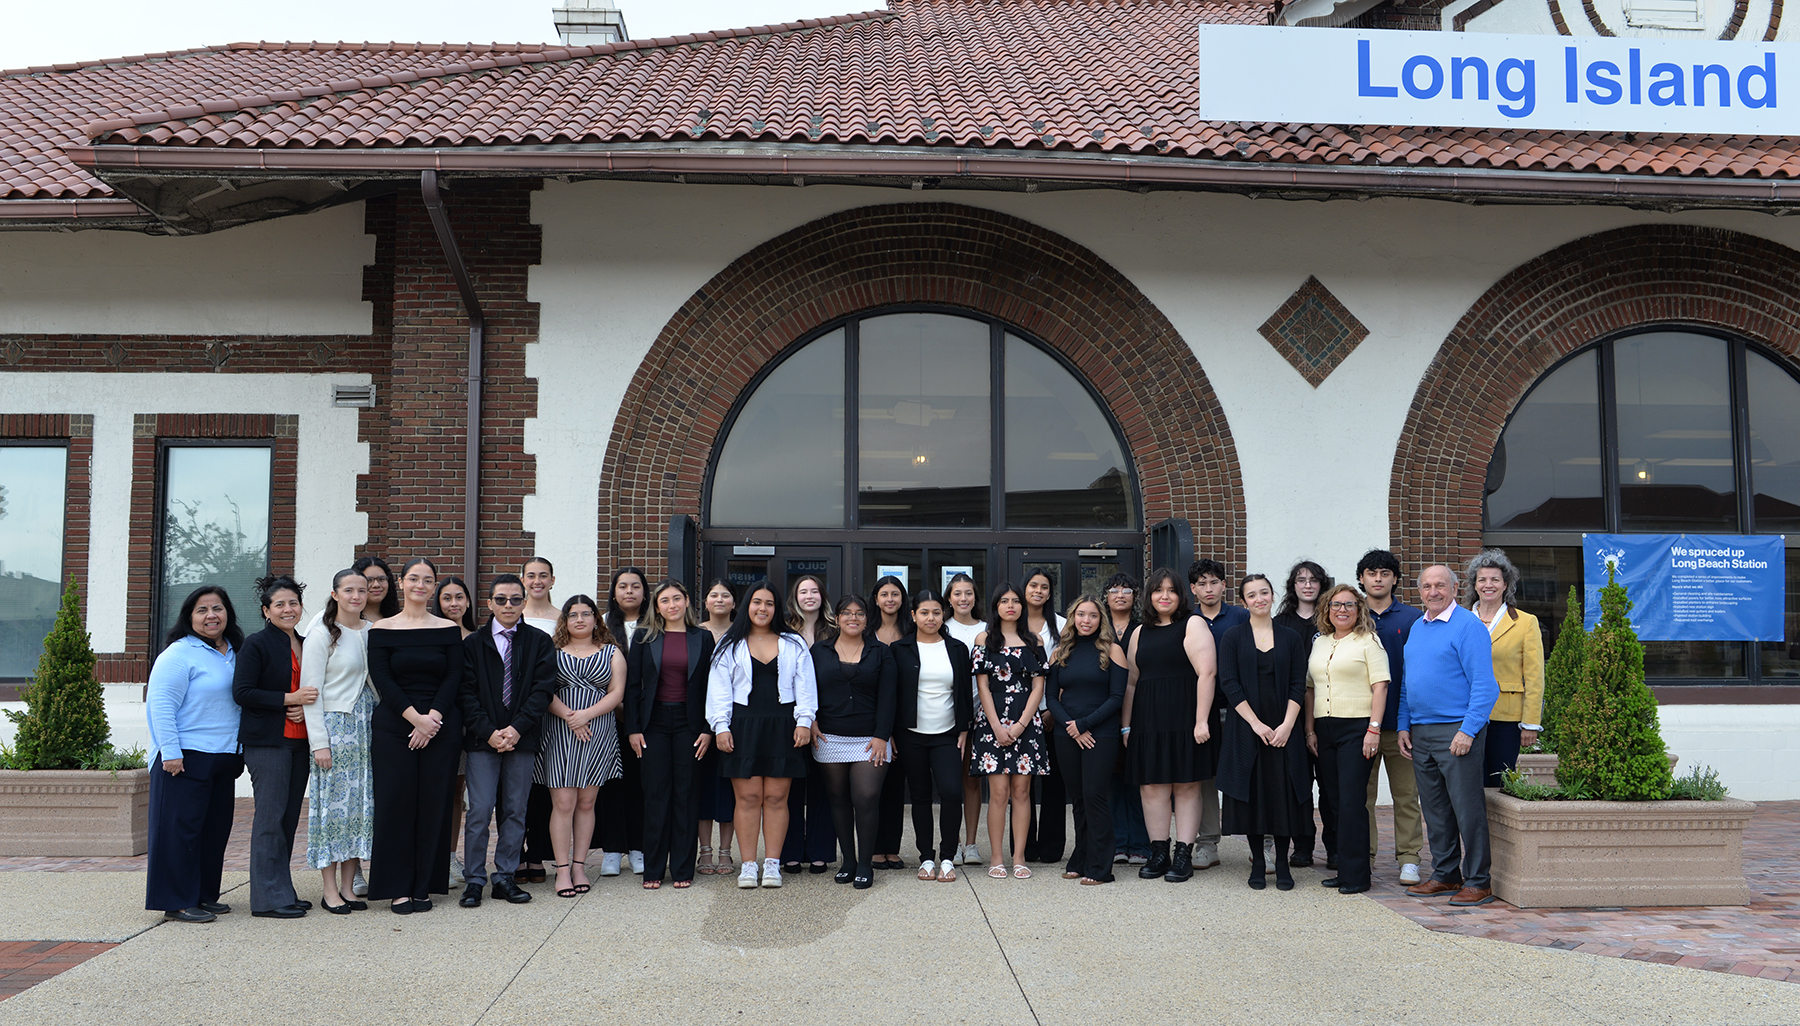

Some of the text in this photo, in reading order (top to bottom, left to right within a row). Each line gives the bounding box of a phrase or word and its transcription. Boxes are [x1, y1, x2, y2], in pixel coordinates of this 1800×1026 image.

[1357, 39, 1777, 118] Long Island
[1671, 547, 1745, 558] We spruced up
[1672, 558, 1767, 570] Long Beach Station
